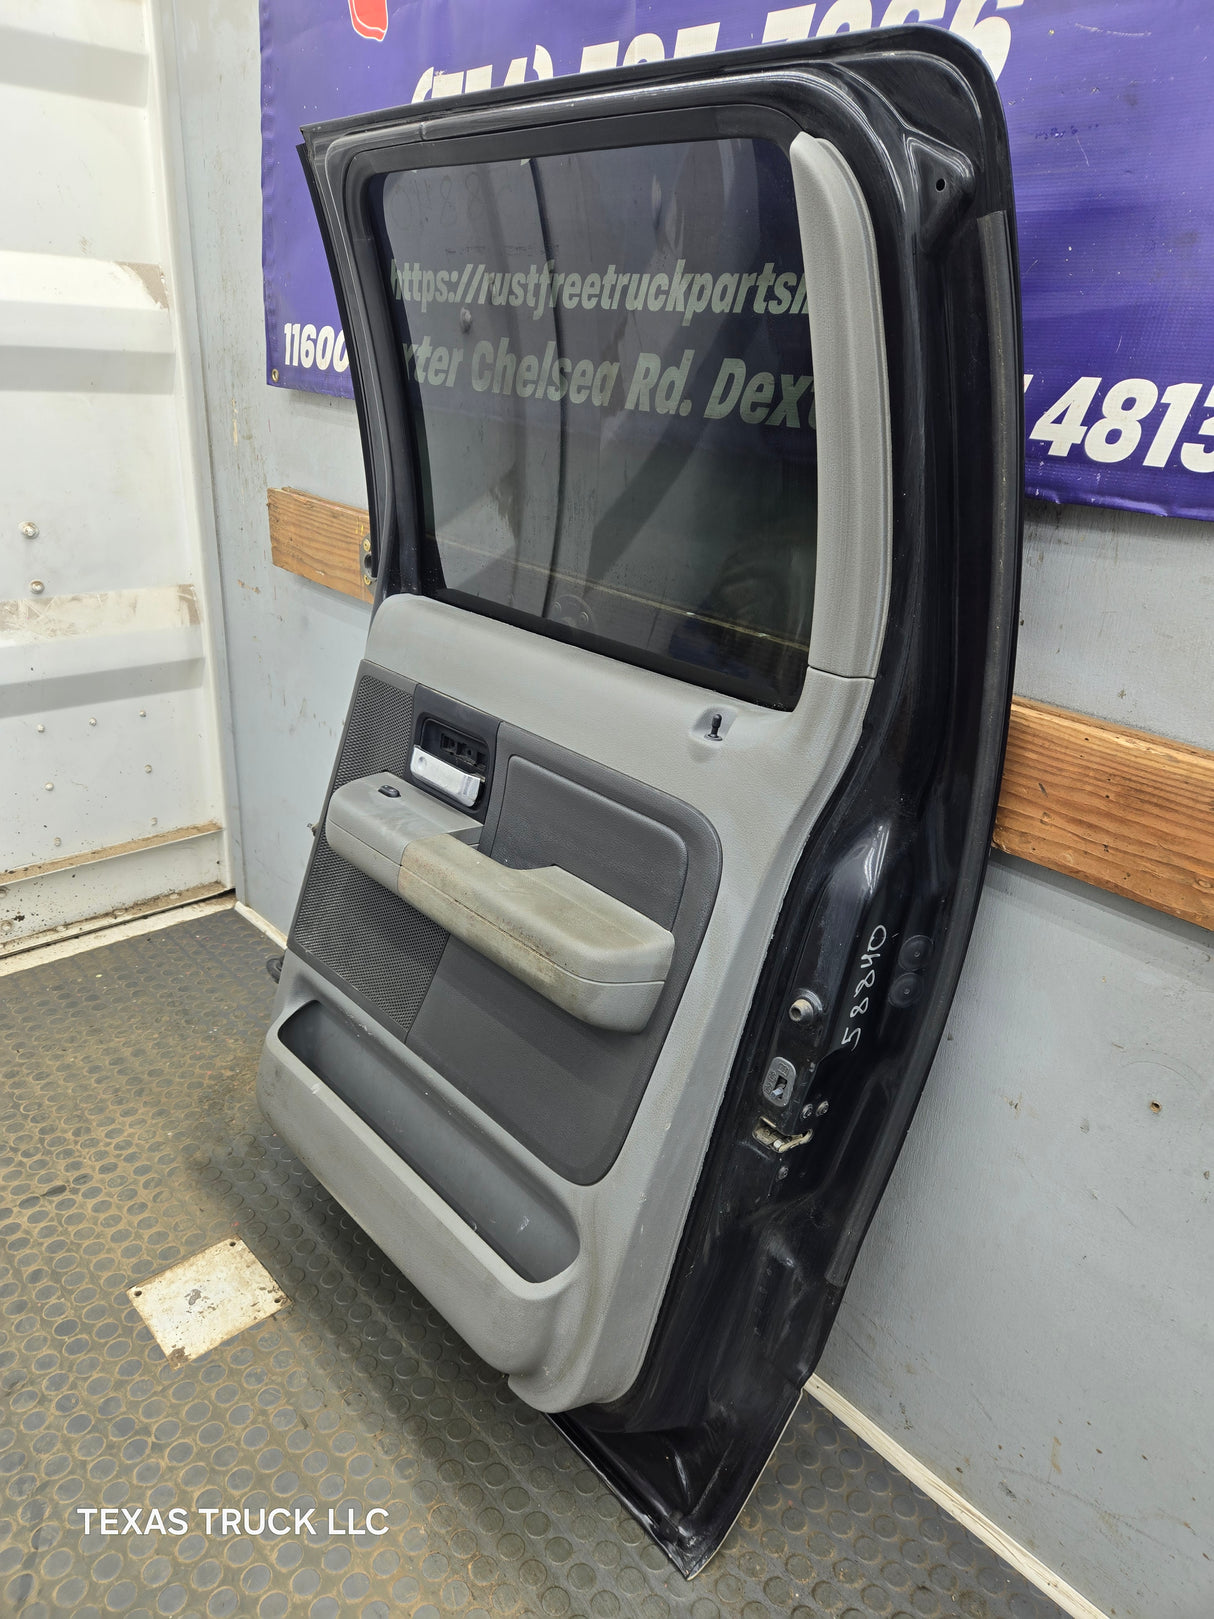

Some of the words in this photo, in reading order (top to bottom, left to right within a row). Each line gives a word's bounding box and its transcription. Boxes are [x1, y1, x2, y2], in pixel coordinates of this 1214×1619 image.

[284, 322, 350, 373] 11600
[471, 337, 620, 407] Chelsea
[625, 349, 695, 417] Rd.
[703, 357, 817, 430] Dex
